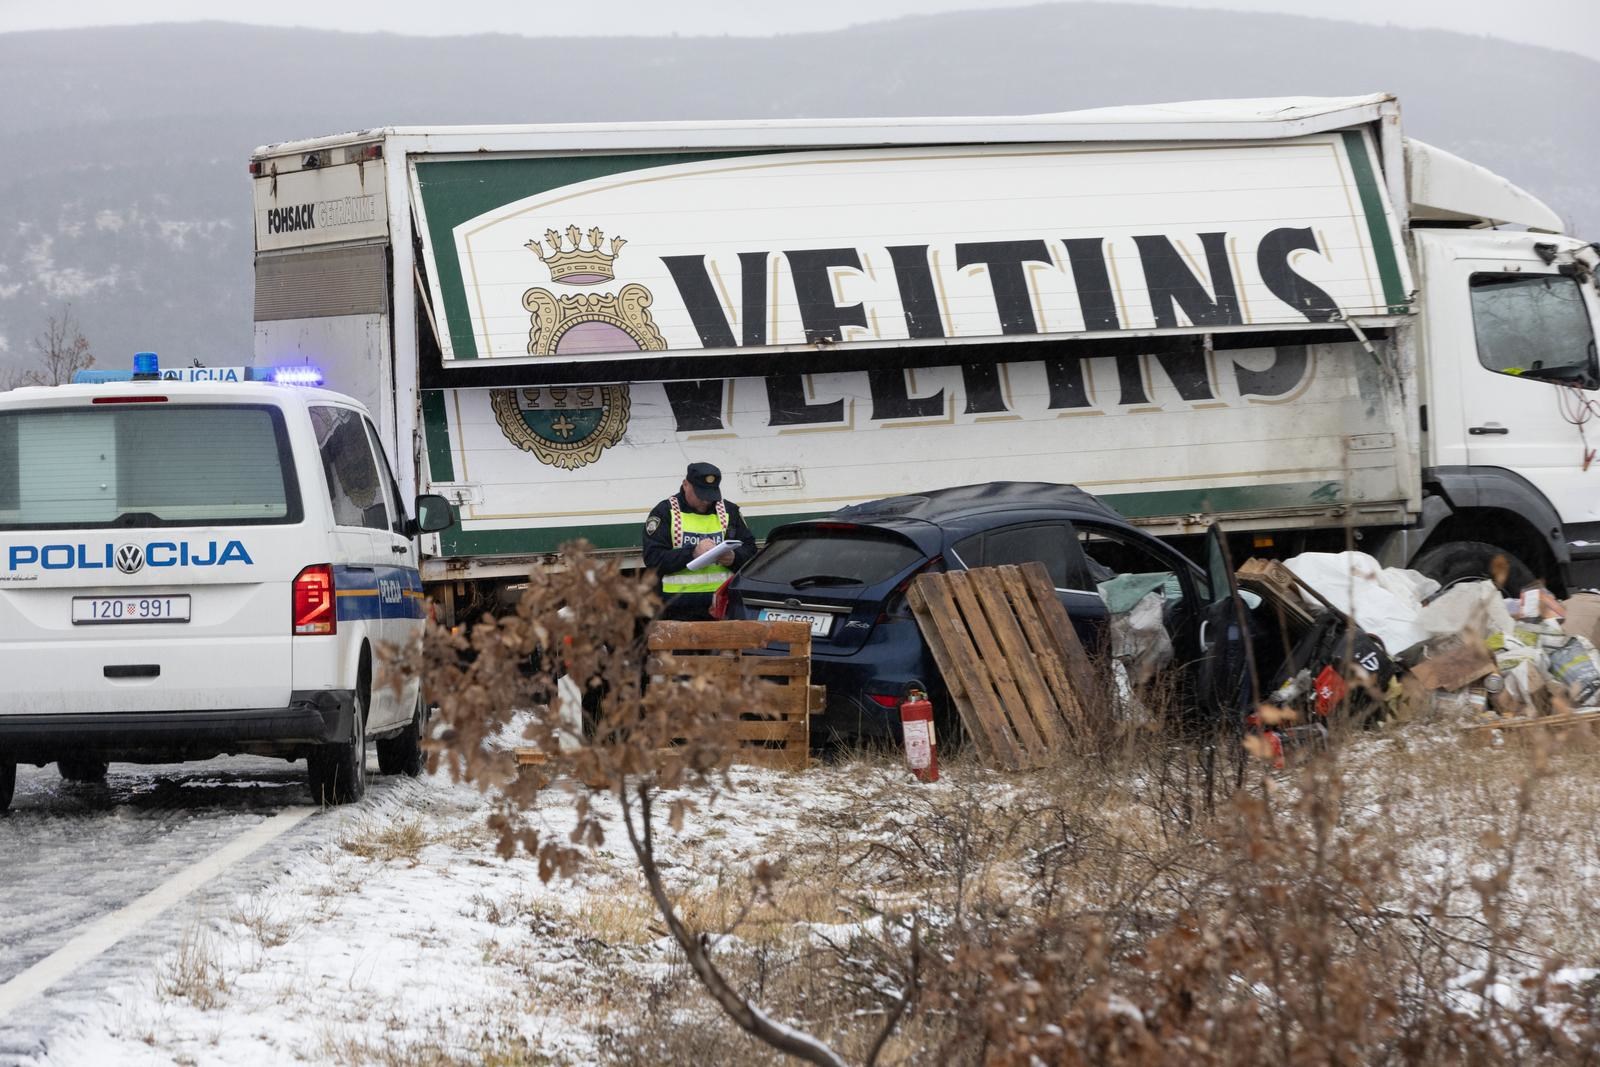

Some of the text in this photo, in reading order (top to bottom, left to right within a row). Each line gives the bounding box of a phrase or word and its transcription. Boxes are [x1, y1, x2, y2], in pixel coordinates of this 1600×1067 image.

[267, 203, 316, 235] FOHSACK
[91, 599, 171, 618] 120 991
